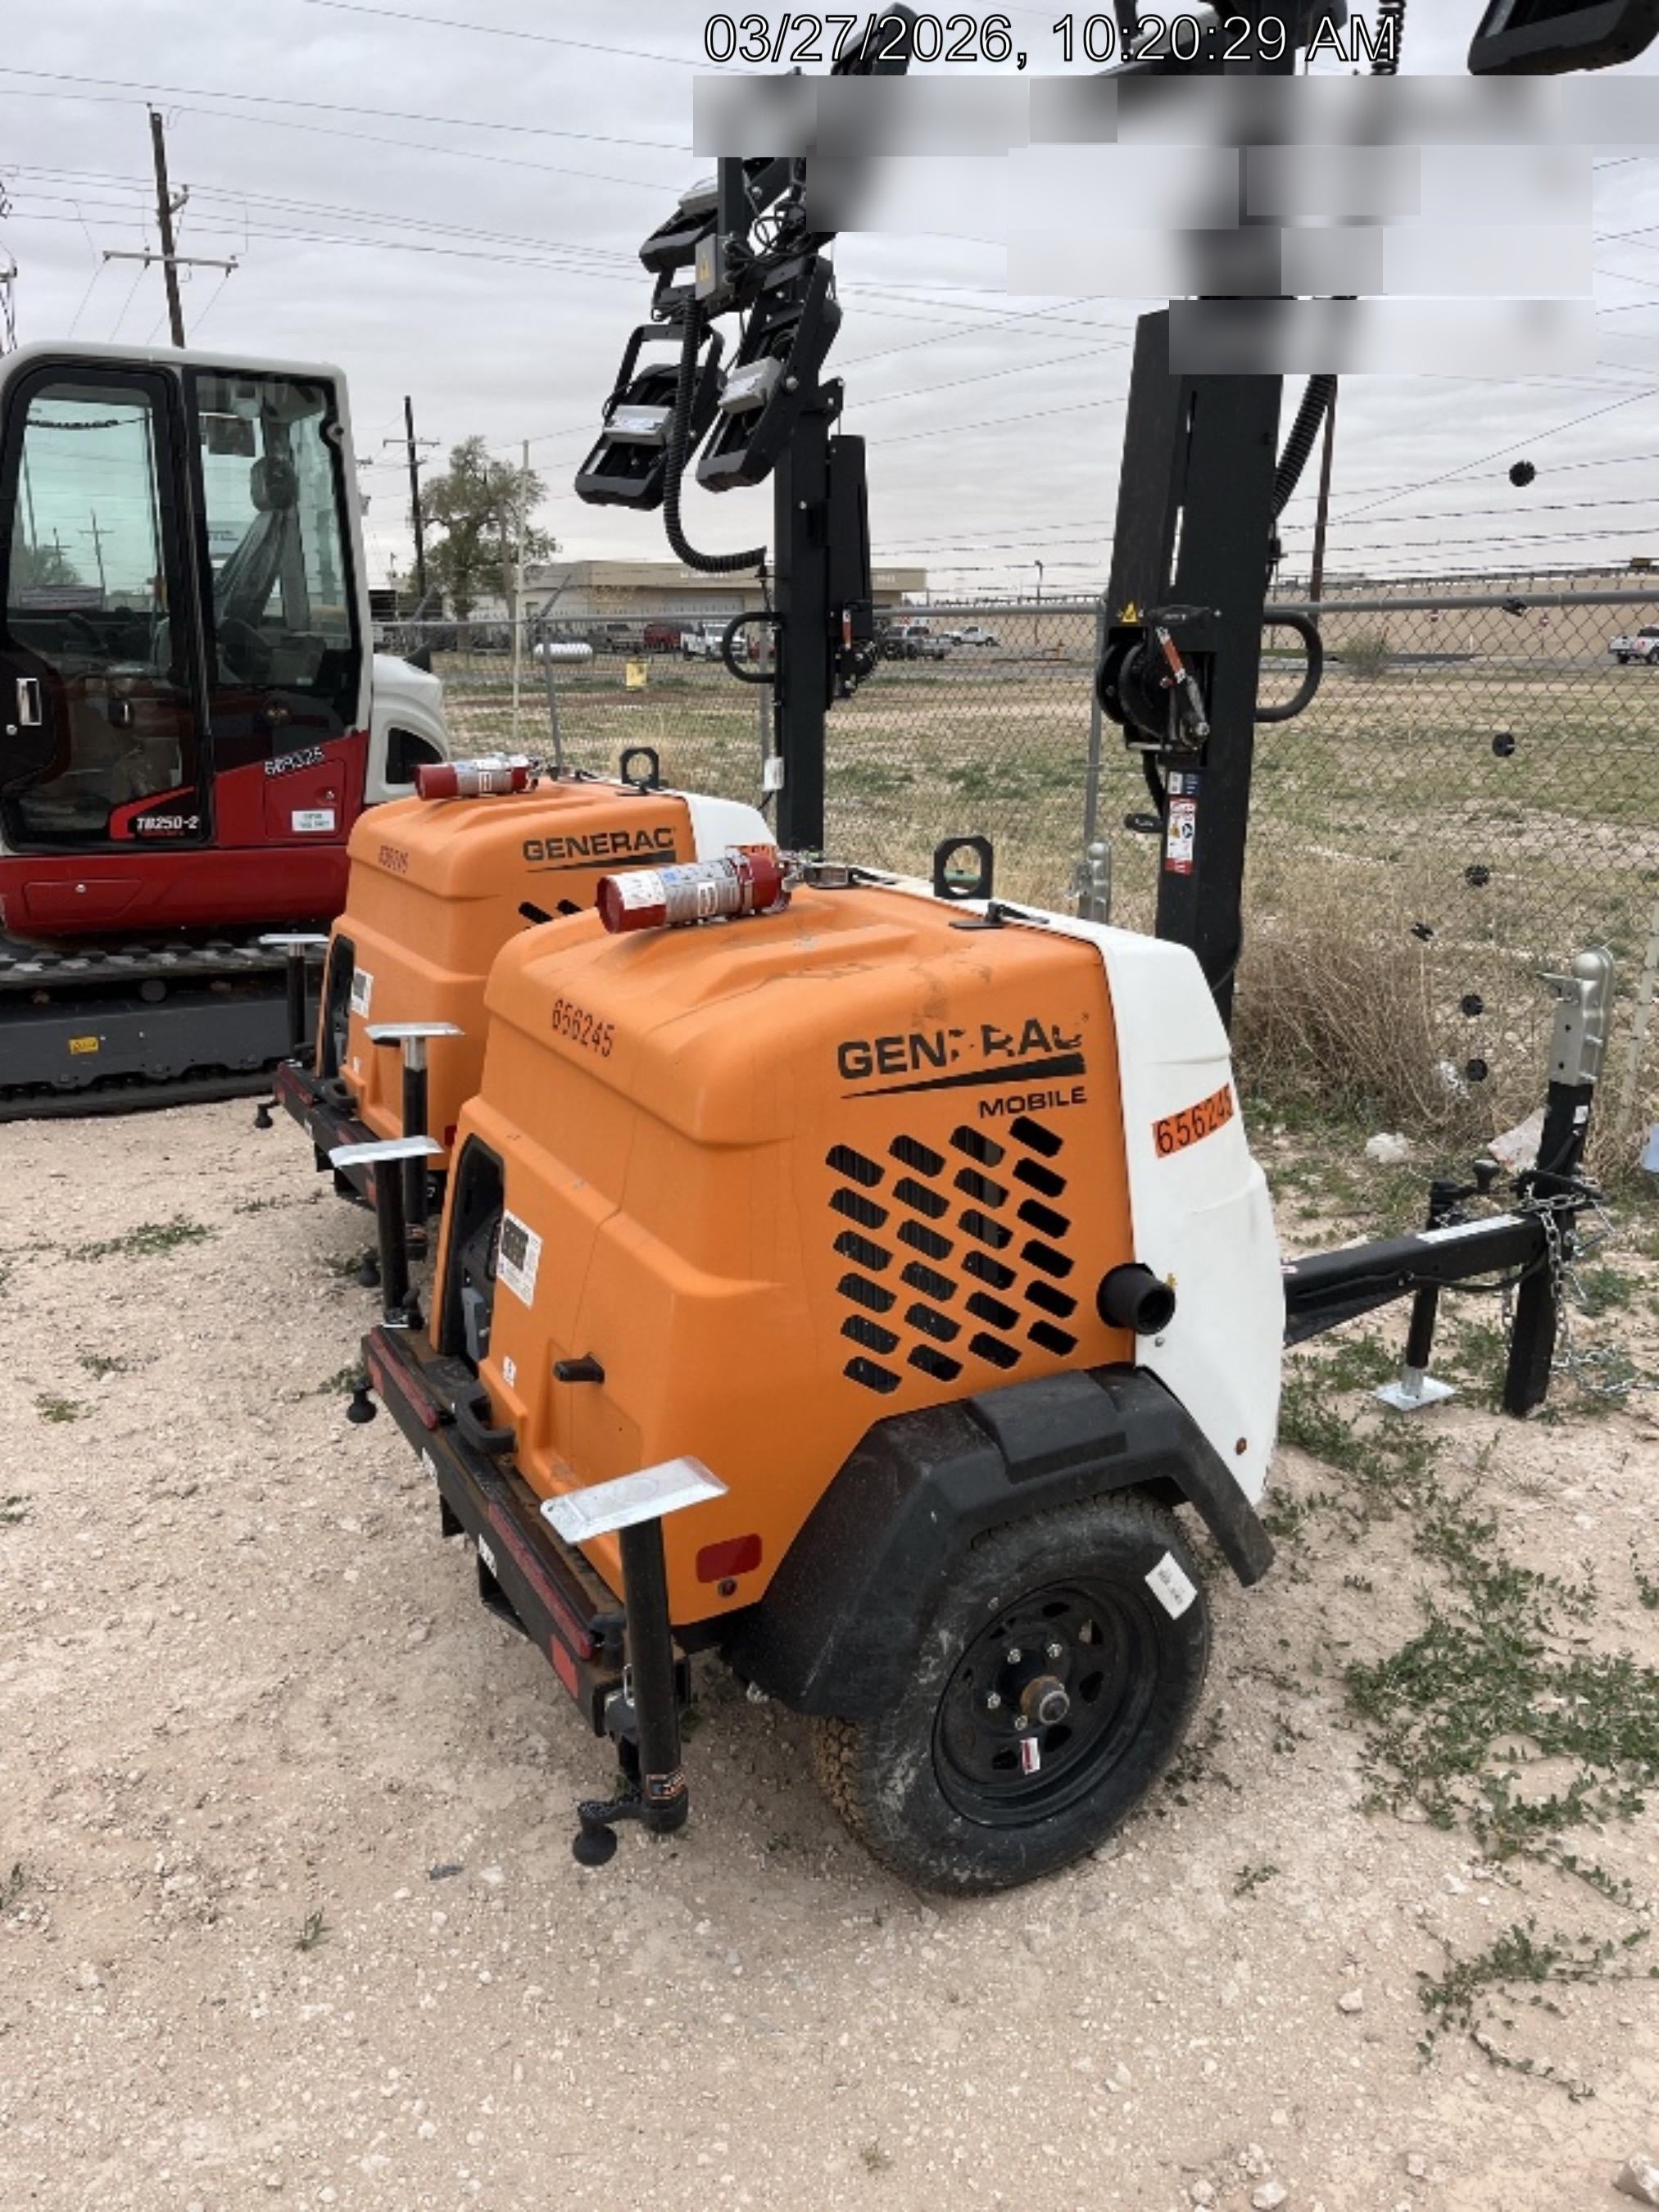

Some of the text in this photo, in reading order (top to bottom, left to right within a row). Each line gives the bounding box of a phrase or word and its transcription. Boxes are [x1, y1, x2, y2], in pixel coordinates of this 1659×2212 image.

[524, 827, 674, 861] GENERAC
[552, 999, 614, 1058] 656245
[837, 1018, 1082, 1080] GENRAC
[978, 1086, 1087, 1118] MOBILE
